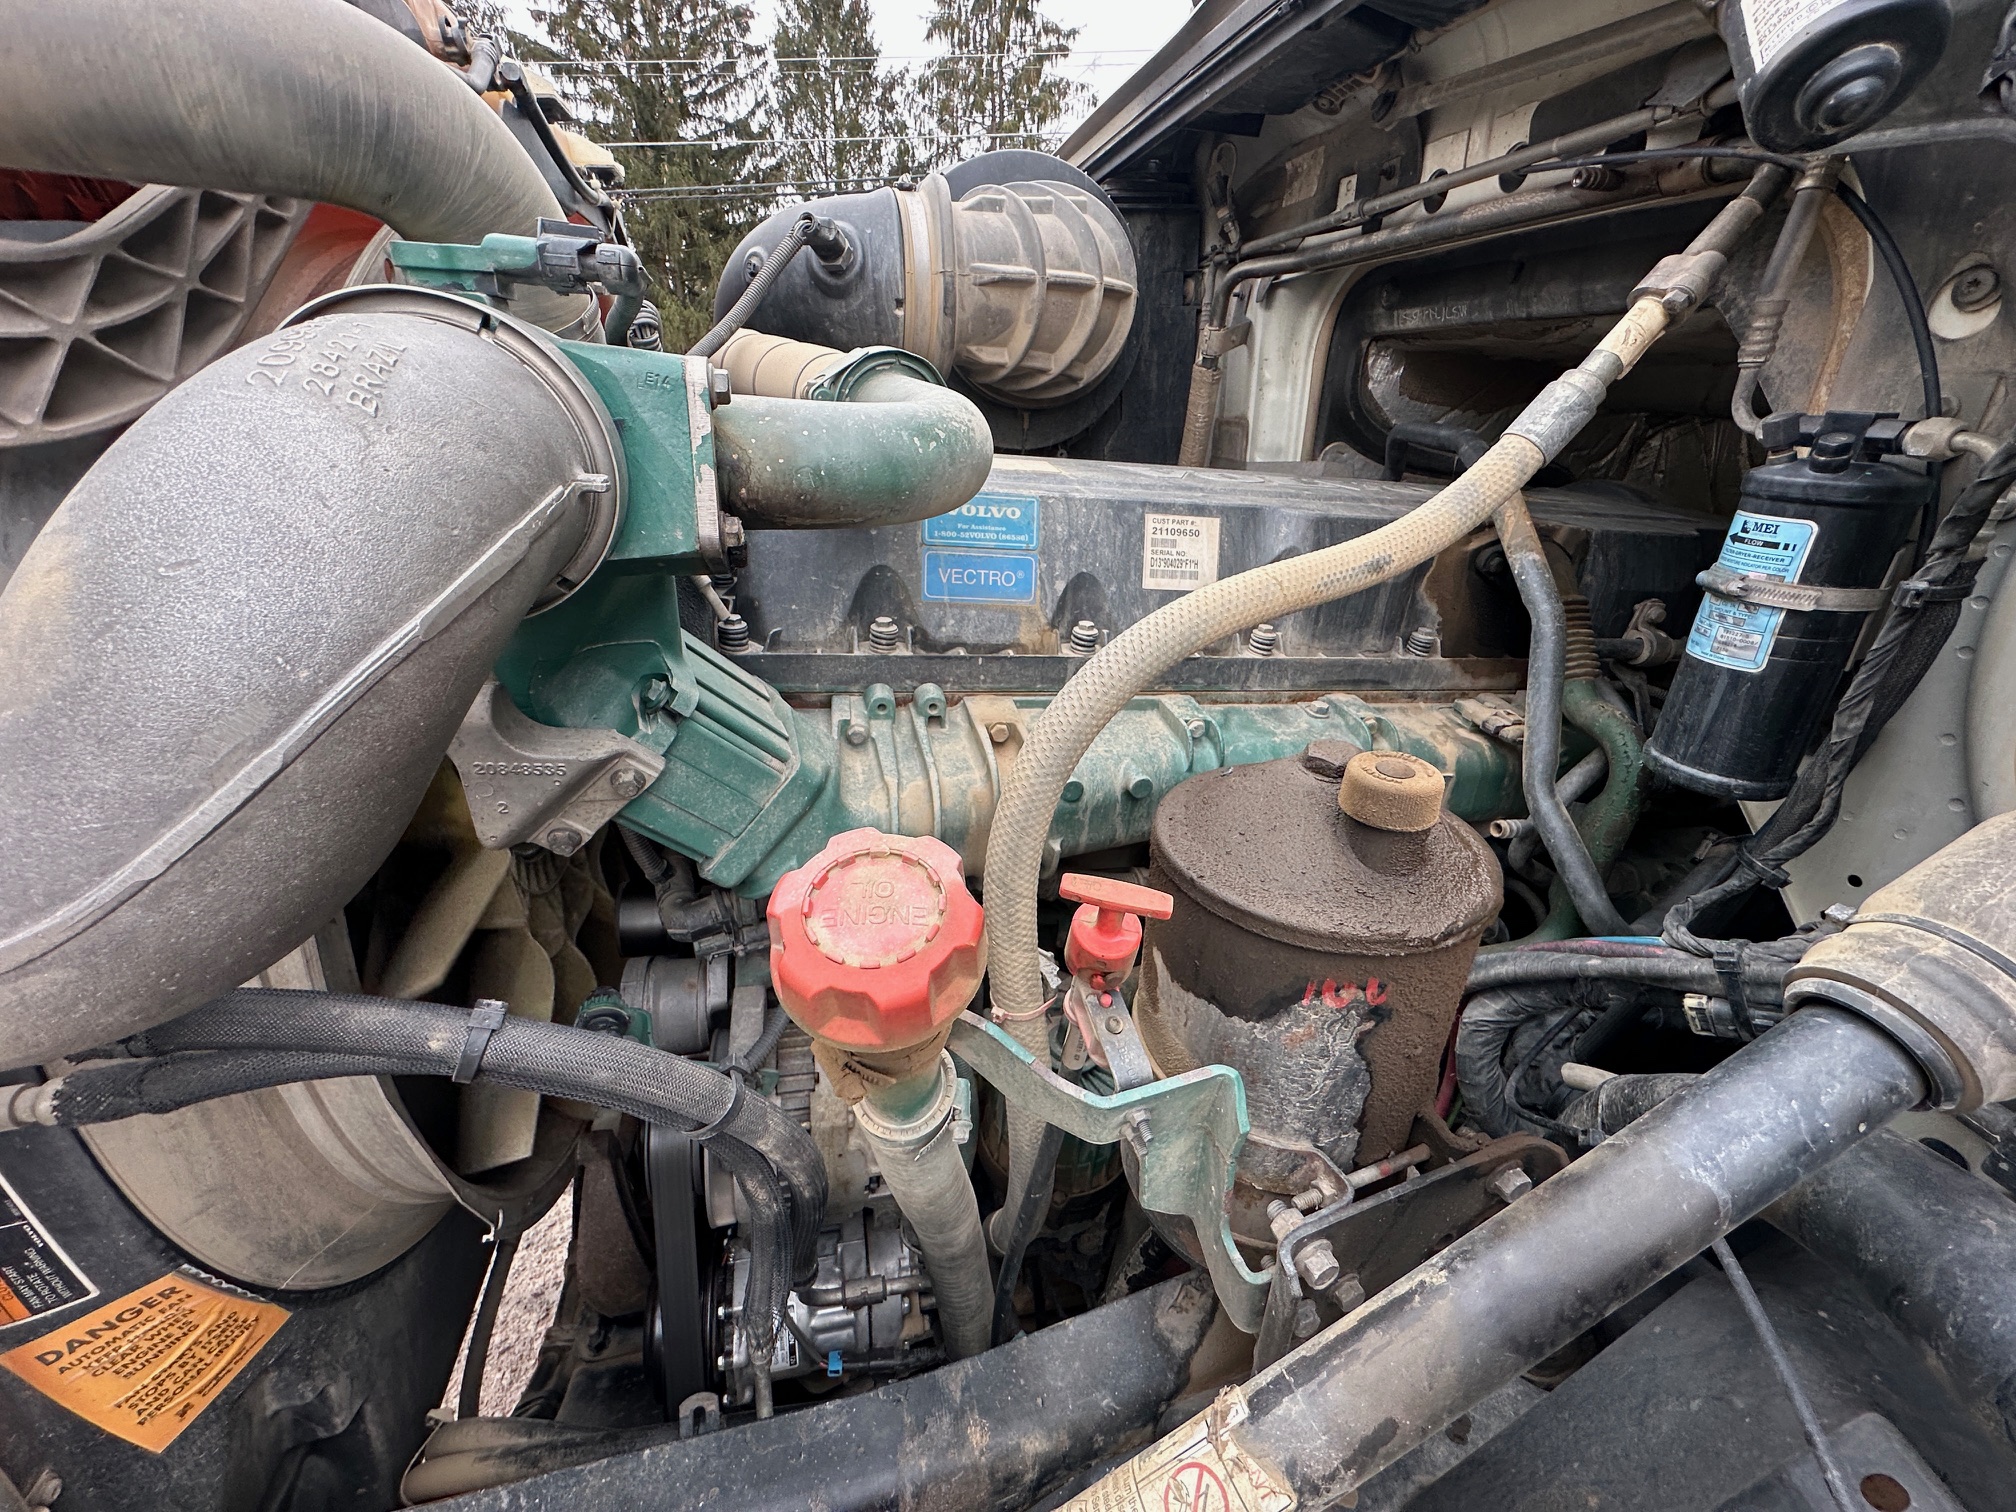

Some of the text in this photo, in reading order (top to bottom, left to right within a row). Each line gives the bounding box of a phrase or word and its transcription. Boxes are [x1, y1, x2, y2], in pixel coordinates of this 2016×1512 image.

[346, 340, 408, 418] BRAZIL
[934, 530, 997, 540] 1-800-52VOLVO
[1152, 526, 1200, 538] 21109650
[1171, 518, 1190, 526] PART
[1744, 538, 1764, 547] FLOW
[1752, 521, 1781, 535] MEI
[497, 801, 509, 814] 2
[851, 881, 895, 899] OIL
[820, 904, 929, 928] ENGINE
[1, 1265, 44, 1309] FAN MAY START
[24, 1247, 73, 1299] WITHOUT WARNING
[26, 1272, 58, 1304] TO ROTATE
[35, 1285, 185, 1367] DANGER
[58, 1315, 156, 1376] AUTOMATIC
[158, 1293, 194, 1315] FAN
[91, 1308, 197, 1378] CLEAR WHEN
[112, 1333, 175, 1376] ENGINE
[176, 1319, 194, 1332] IS
[82, 1344, 123, 1371] KEEP
[114, 1383, 150, 1409] FAN
[150, 1339, 203, 1382] STARTS
[207, 1311, 238, 1337] AND
[122, 1323, 200, 1380] RUNNING
[128, 1316, 240, 1411] STOPS BY ITSELF
[136, 1387, 170, 1418] AND
[173, 1357, 205, 1385] CAN
[207, 1317, 250, 1355] CAUSE
[137, 1360, 213, 1426] PERSONAL
[214, 1315, 259, 1358] INJURY
